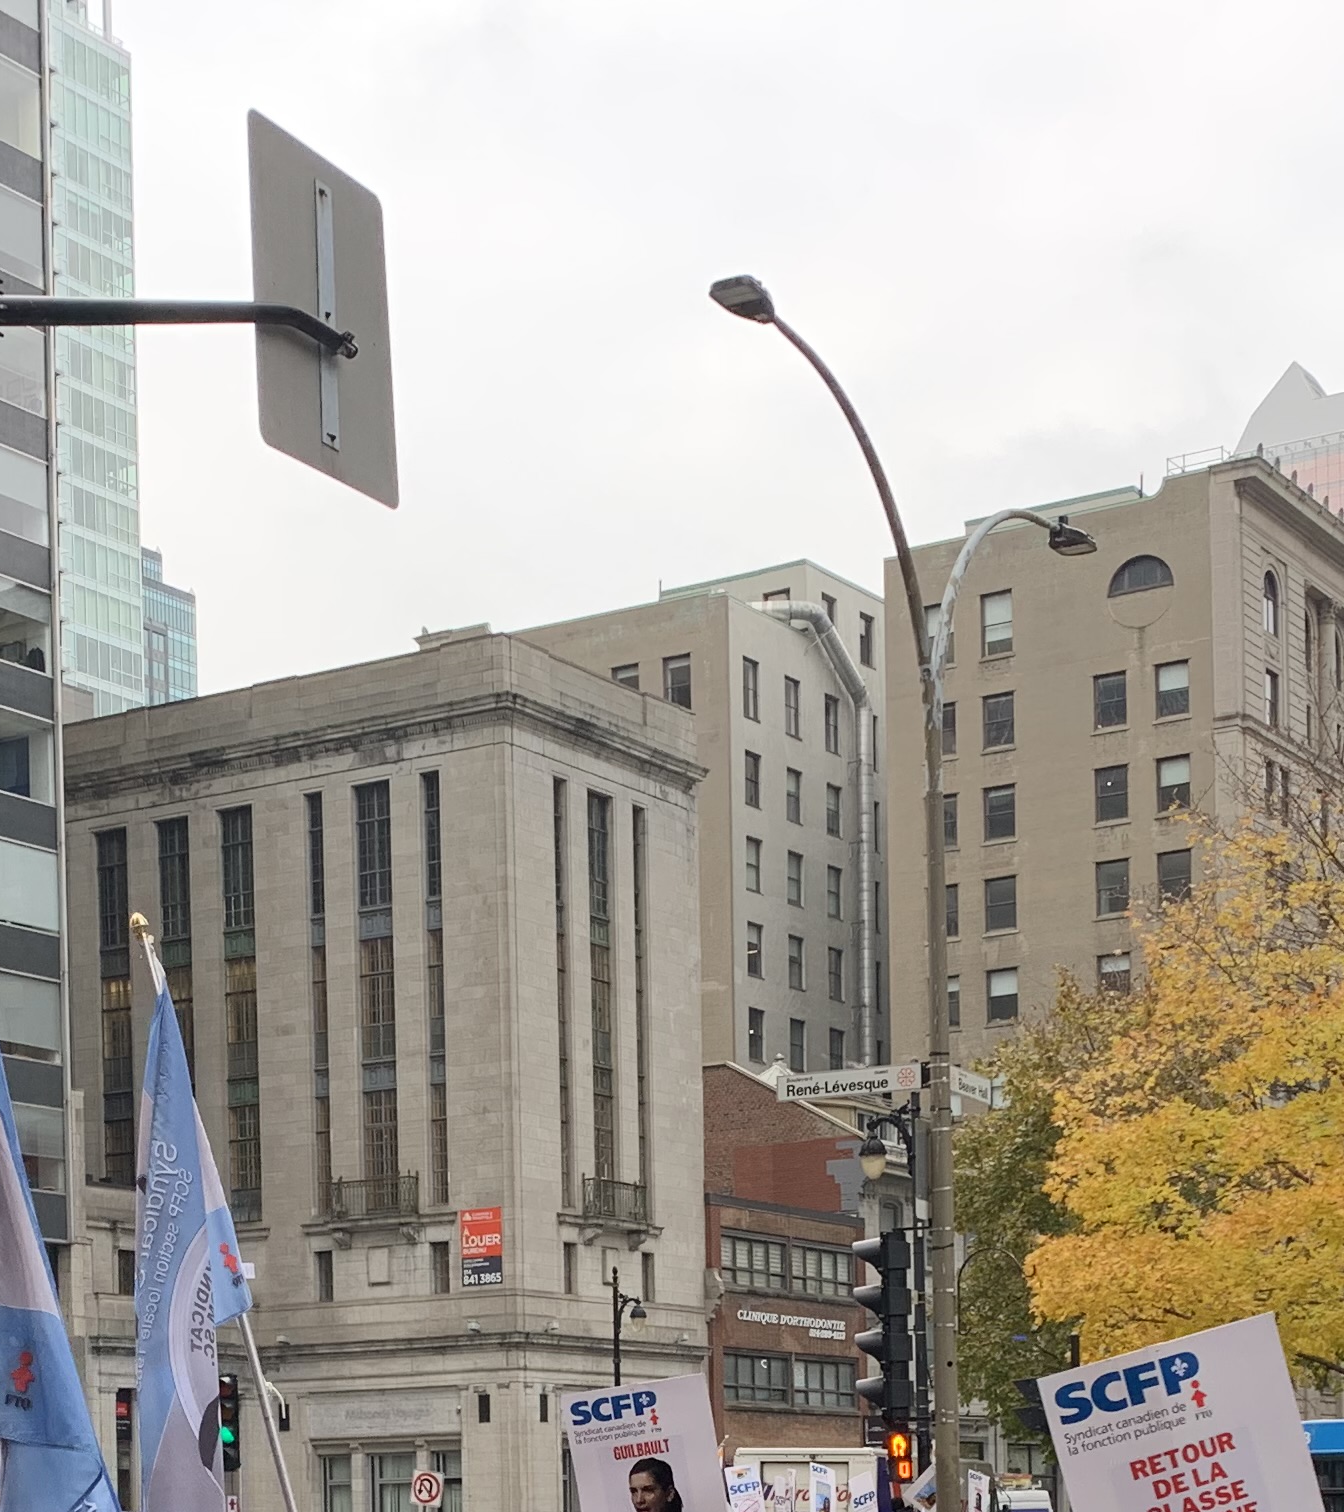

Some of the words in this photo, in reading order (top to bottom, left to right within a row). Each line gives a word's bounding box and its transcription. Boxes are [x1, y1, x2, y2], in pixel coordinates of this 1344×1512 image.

[786, 1078, 889, 1098] René-Lévesque
[958, 1077, 975, 1095] Beaver
[462, 1233, 501, 1248] LOUER
[463, 1274, 478, 1286] 841
[479, 1272, 502, 1284] 3865
[737, 1309, 779, 1325] CLINIQUE
[780, 1314, 846, 1331] D'ORTHODONTIE
[1055, 1351, 1199, 1425] SCFP
[570, 1390, 657, 1426] SCFP
[574, 1427, 603, 1438] Syndicat
[604, 1423, 636, 1433] canadien
[637, 1420, 647, 1428] de
[1064, 1423, 1113, 1444] Syndicat
[1116, 1408, 1169, 1430] canadien
[1171, 1402, 1187, 1414] de
[583, 1433, 613, 1443] fonction
[614, 1429, 646, 1440] publique
[1066, 1445, 1079, 1456] la
[1081, 1432, 1132, 1453] fonction
[1134, 1416, 1186, 1440] publique
[613, 1438, 671, 1461] GUILBAULT
[1129, 1432, 1236, 1480] RETOUR
[811, 1465, 828, 1474] SCFP
[730, 1481, 760, 1495] SCFP
[1152, 1472, 1190, 1500] DE
[1191, 1461, 1229, 1488] LA
[853, 1491, 875, 1508] SCFP
